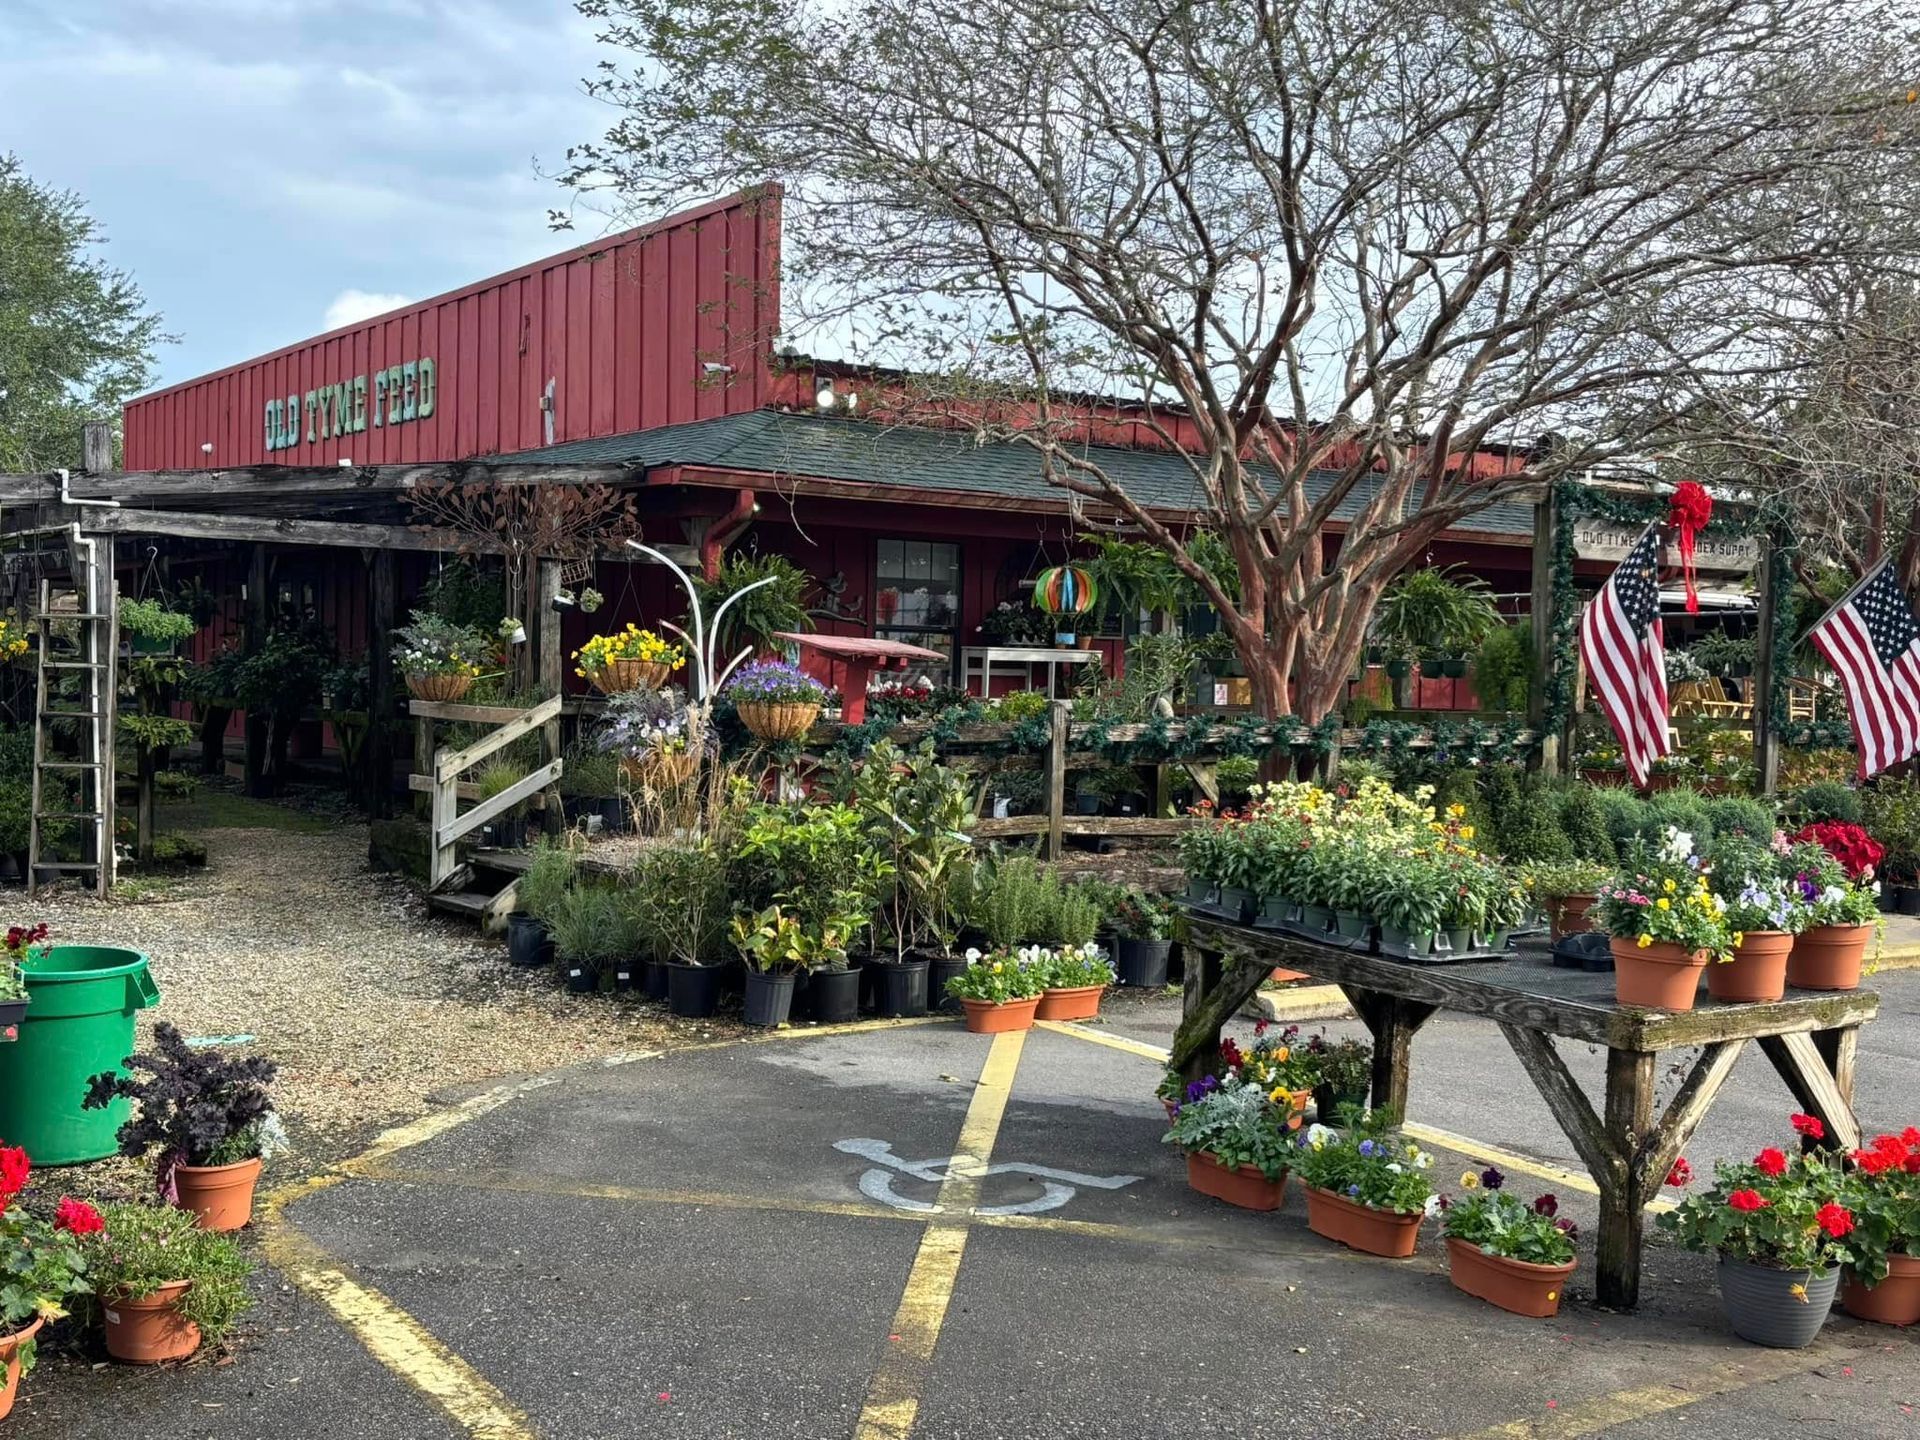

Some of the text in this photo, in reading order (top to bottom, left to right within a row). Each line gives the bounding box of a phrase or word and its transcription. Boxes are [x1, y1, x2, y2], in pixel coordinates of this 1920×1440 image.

[265, 357, 436, 451] OLD TYME FEED
